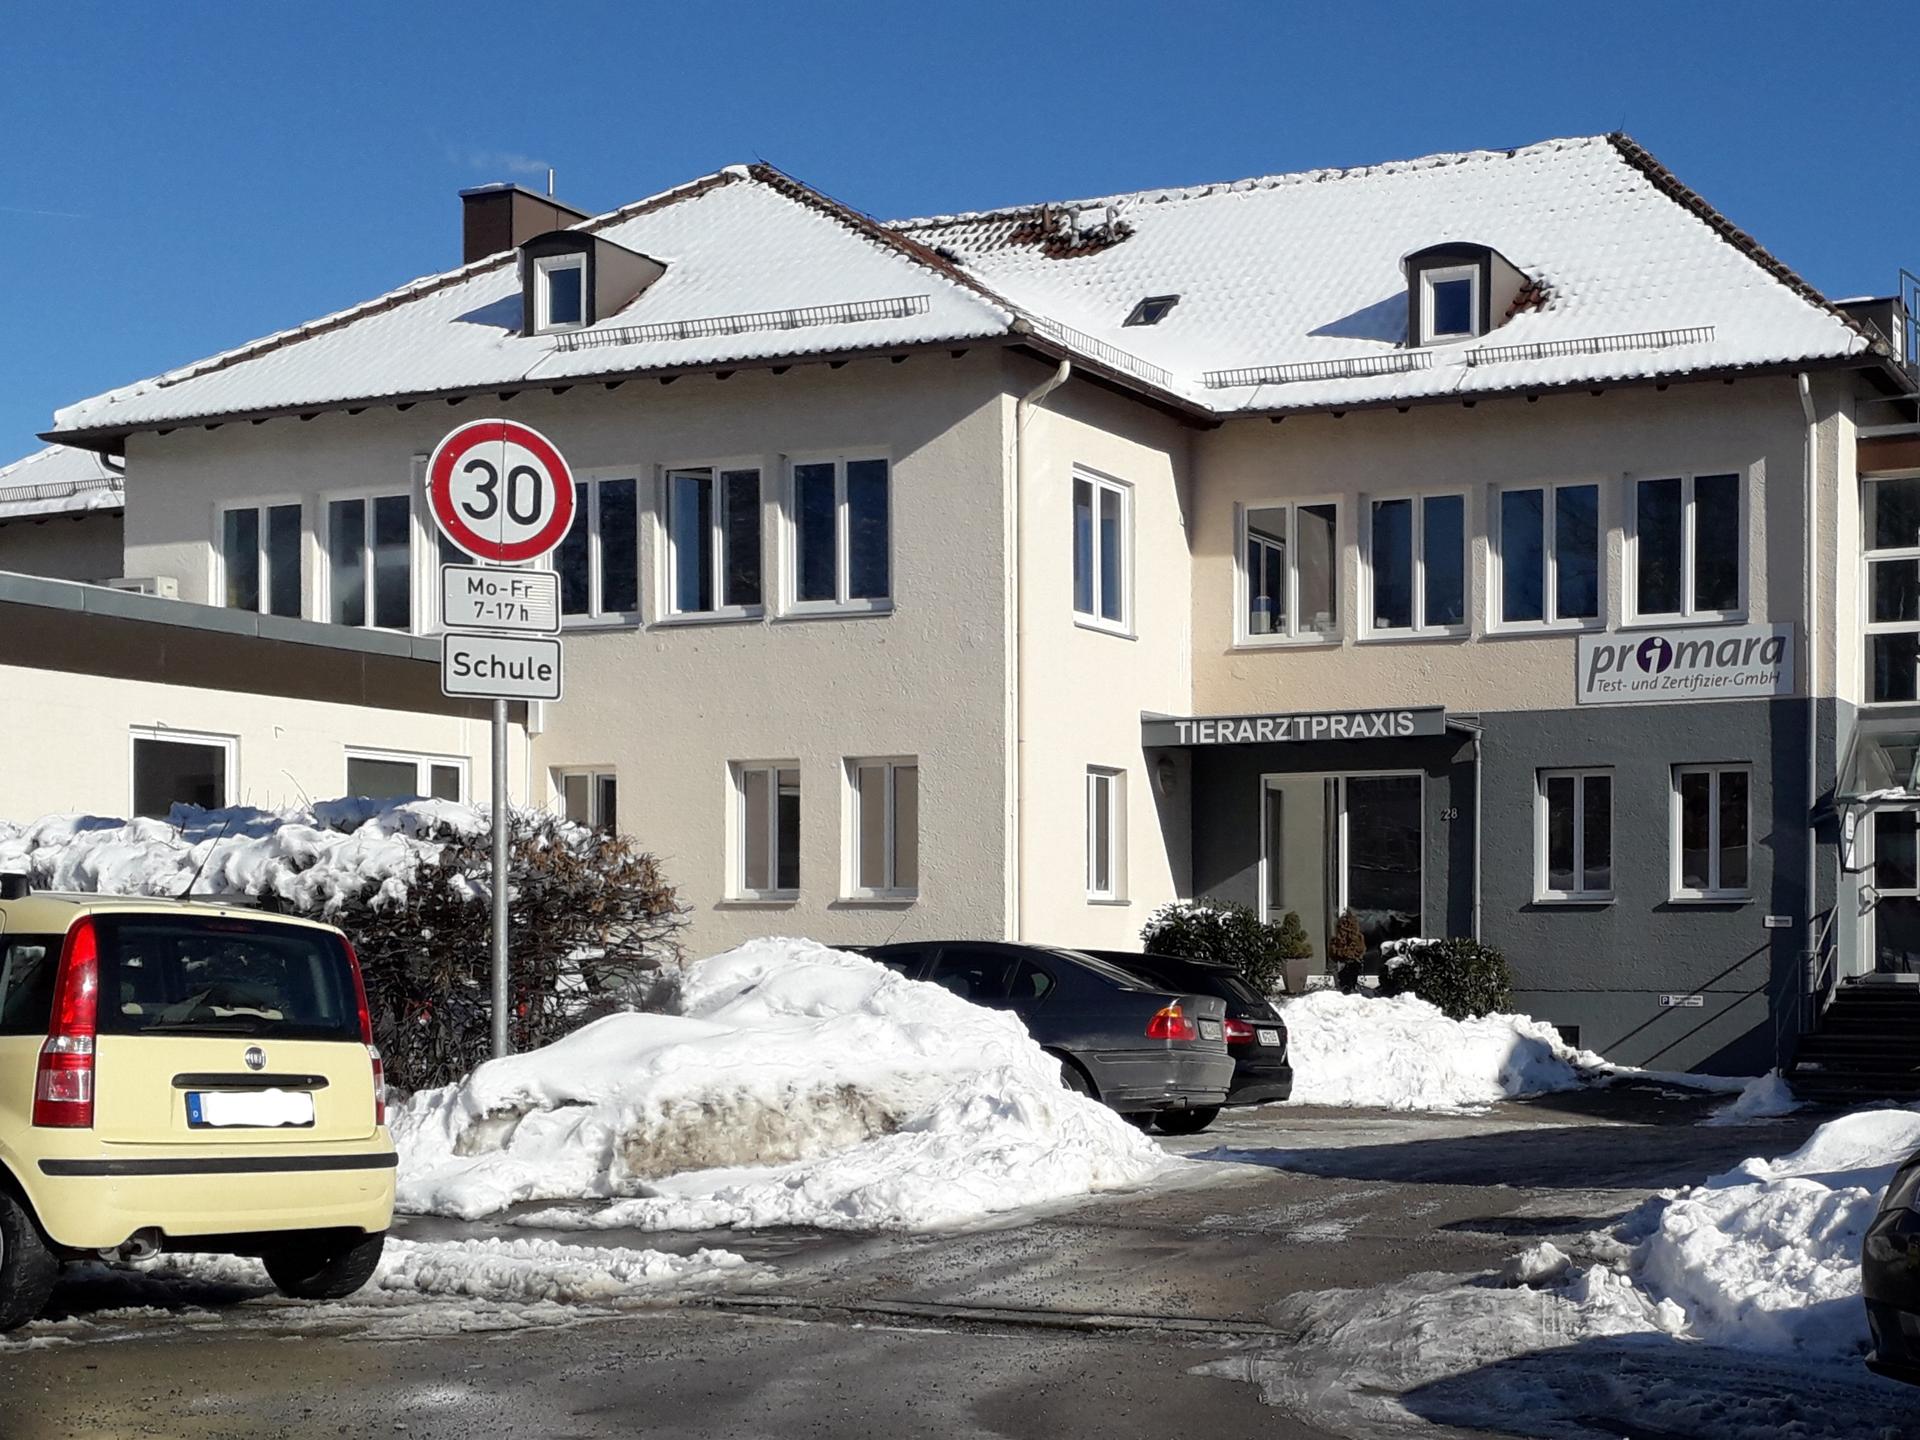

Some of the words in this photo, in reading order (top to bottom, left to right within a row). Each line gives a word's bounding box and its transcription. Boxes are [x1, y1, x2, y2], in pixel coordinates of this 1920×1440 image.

[461, 459, 542, 525] 30
[467, 576, 533, 598] Mo-Fr
[453, 651, 552, 681] Schule
[1586, 636, 1787, 693] primara
[1597, 679, 1628, 692] Test-
[1631, 676, 1659, 691] und
[1661, 670, 1780, 693] Zertifizier-GmbH
[1174, 711, 1415, 744] TIERARZTPRAXIS
[1443, 807, 1458, 820] 28
